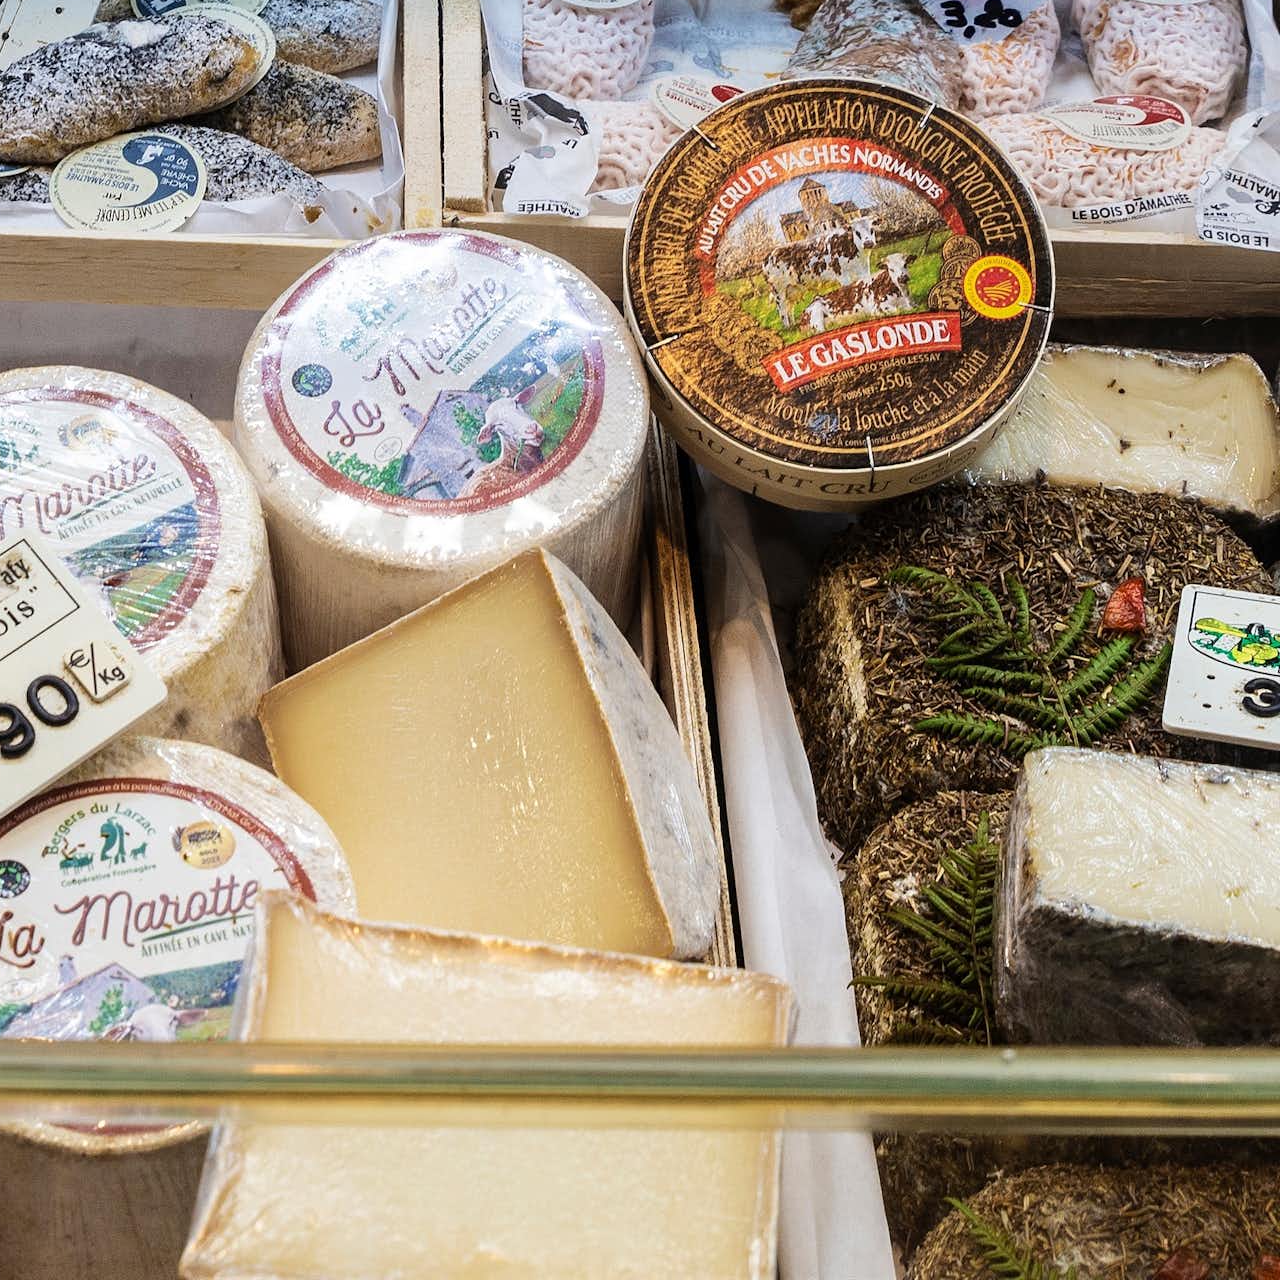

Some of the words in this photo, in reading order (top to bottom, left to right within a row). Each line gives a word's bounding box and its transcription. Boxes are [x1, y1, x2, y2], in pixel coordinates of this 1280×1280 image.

[660, 200, 695, 233] DE
[764, 99, 882, 138] APPELLATION
[885, 111, 968, 175] D'ORIGINE
[954, 162, 1018, 244] PROTÉGÉE
[773, 143, 852, 170] VACHES
[748, 160, 778, 186] DE
[854, 148, 946, 202] NORMANDES
[721, 175, 753, 208] CRU
[1072, 209, 1088, 221] LE
[1090, 206, 1122, 221] BOIS
[1125, 192, 1192, 217] D'AMALTHÉE
[702, 203, 727, 235] LAIT
[699, 232, 714, 255] AU
[1217, 231, 1251, 246] BOIS
[1254, 235, 1269, 247] LE
[363, 277, 508, 397] Marotte
[773, 351, 810, 384] LE
[810, 319, 952, 369] GASLONDE
[798, 369, 857, 396] FROMAGERIE
[907, 352, 942, 366] LESSAY
[877, 372, 914, 392] 250g
[953, 349, 989, 385] main
[928, 386, 941, 405] à
[934, 378, 958, 399] la
[837, 407, 851, 432] la
[856, 400, 913, 431] louche
[913, 395, 930, 416] et
[323, 398, 386, 448] La
[687, 427, 725, 456] AU
[739, 458, 814, 490] LAIT
[820, 478, 891, 497] CRU
[133, 476, 186, 510] NATURELLE
[67, 642, 128, 695] €/Kg
[47, 809, 87, 856] Bergers
[90, 802, 109, 815] du
[114, 803, 157, 837] Larzac
[61, 871, 112, 888] Coopérative
[54, 875, 261, 948] Marotte
[140, 938, 184, 959] AFFINÉE
[187, 936, 202, 949] EN
[203, 931, 231, 947] CAVE
